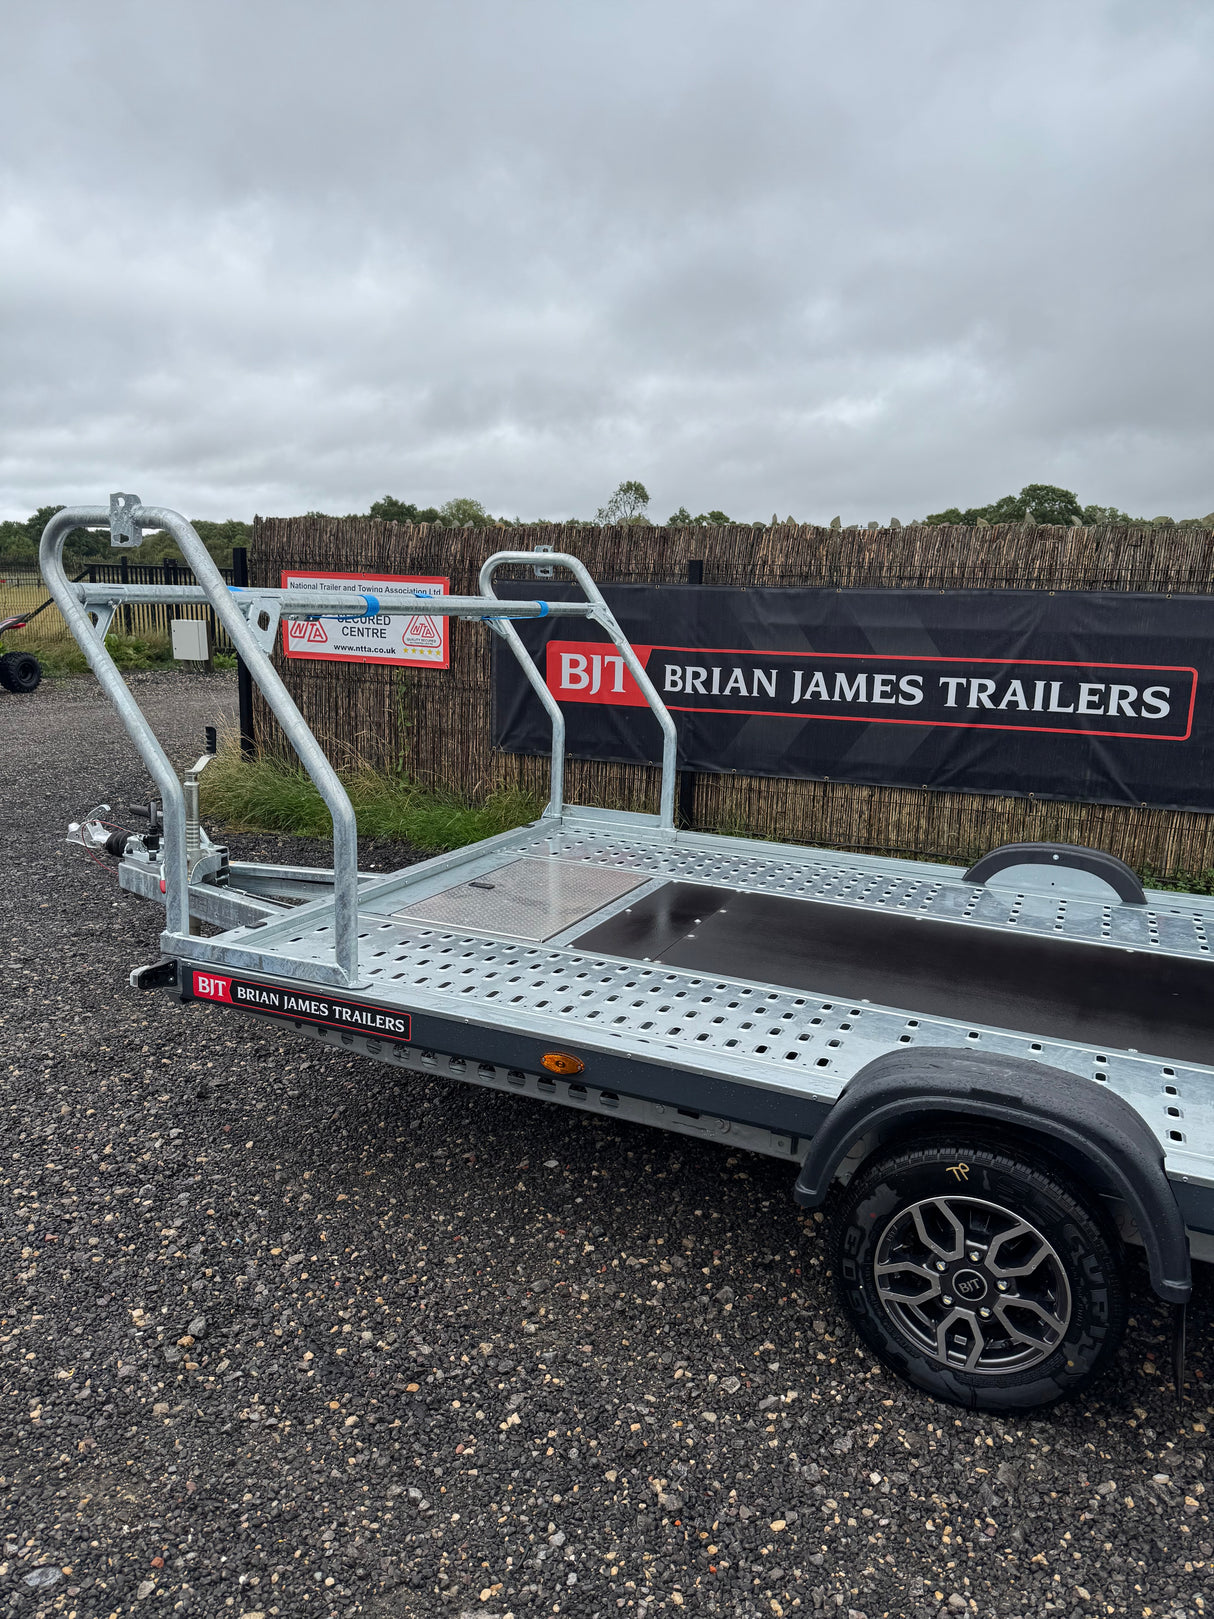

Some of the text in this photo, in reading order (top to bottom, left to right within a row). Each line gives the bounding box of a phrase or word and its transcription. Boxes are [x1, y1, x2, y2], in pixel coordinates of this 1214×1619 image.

[290, 581, 318, 591] National
[319, 583, 341, 591] Trailer
[343, 585, 356, 593] and
[342, 626, 387, 639] CENTRE
[334, 643, 396, 655] www.ntta.co.uk
[559, 653, 625, 694] BJT
[663, 665, 1171, 719] BRIAN JAMES TRAILERS
[198, 976, 226, 996] BJT
[237, 987, 404, 1032] BRIAN JAMES TRAILERS
[958, 1278, 980, 1294] BJT
